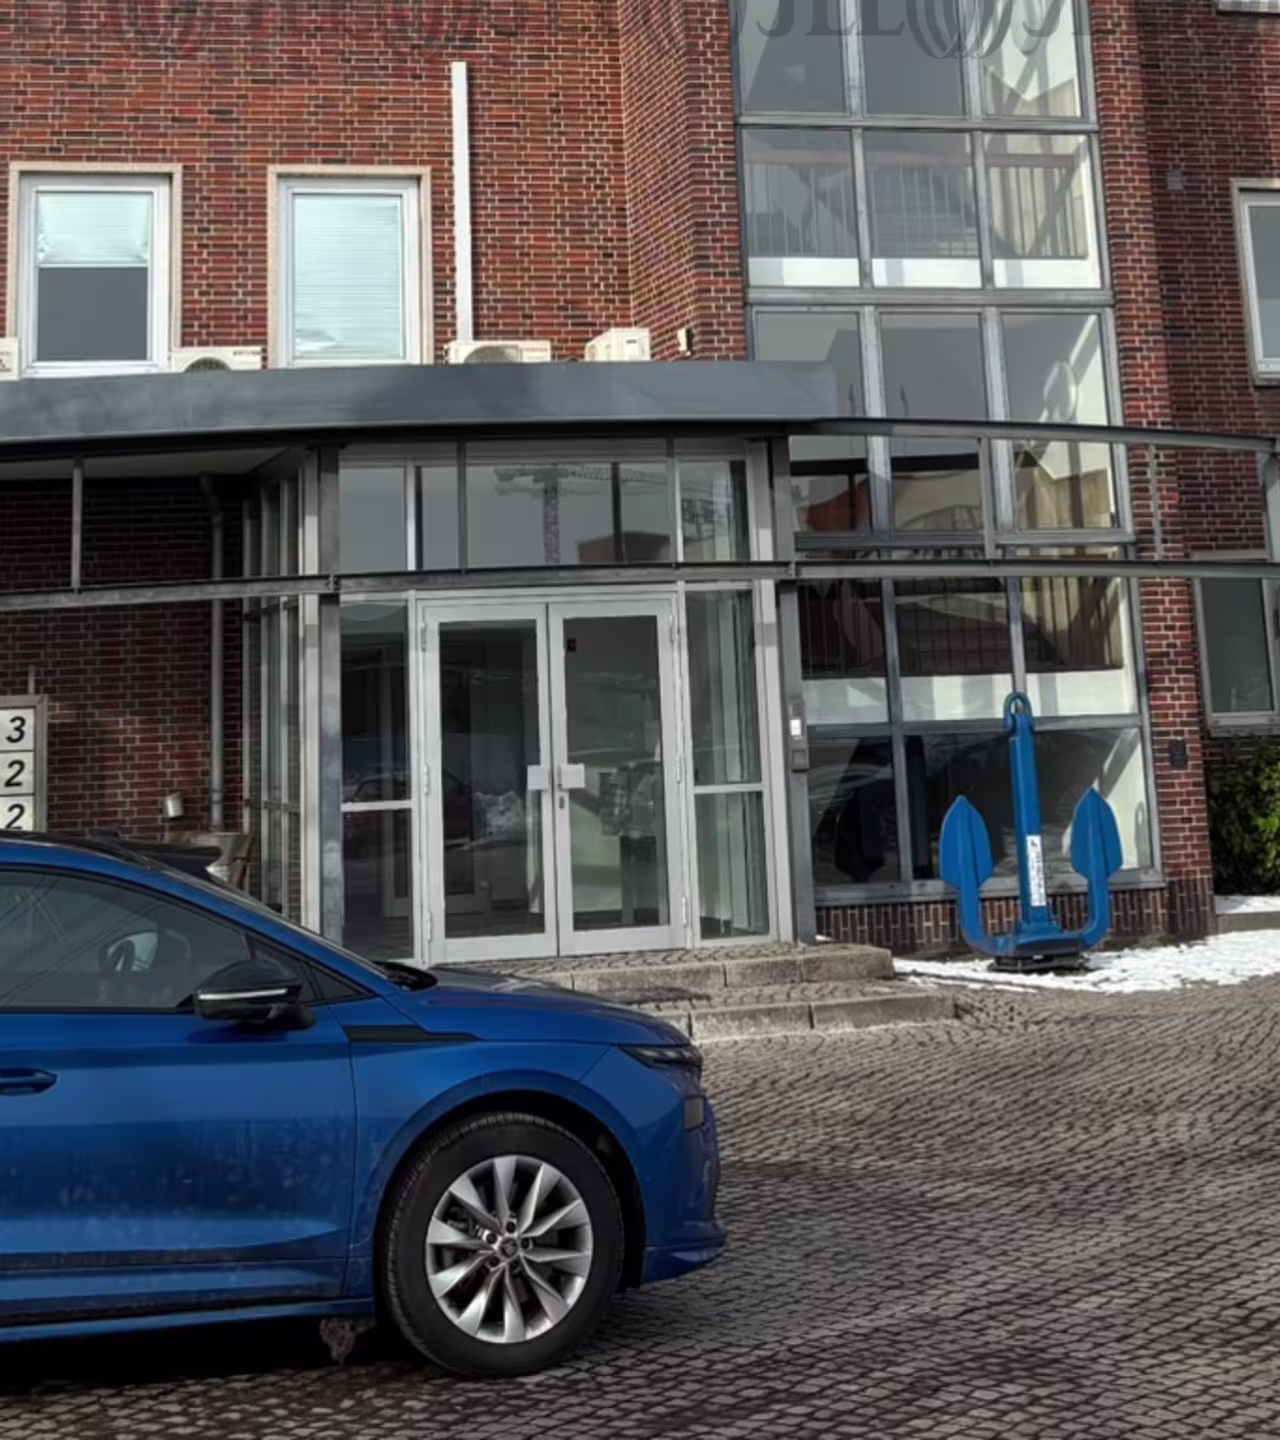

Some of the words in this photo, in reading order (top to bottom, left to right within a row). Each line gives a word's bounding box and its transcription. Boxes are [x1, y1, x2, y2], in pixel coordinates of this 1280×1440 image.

[6, 716, 26, 743] 3
[4, 760, 25, 788] 2
[6, 803, 26, 830] 2
